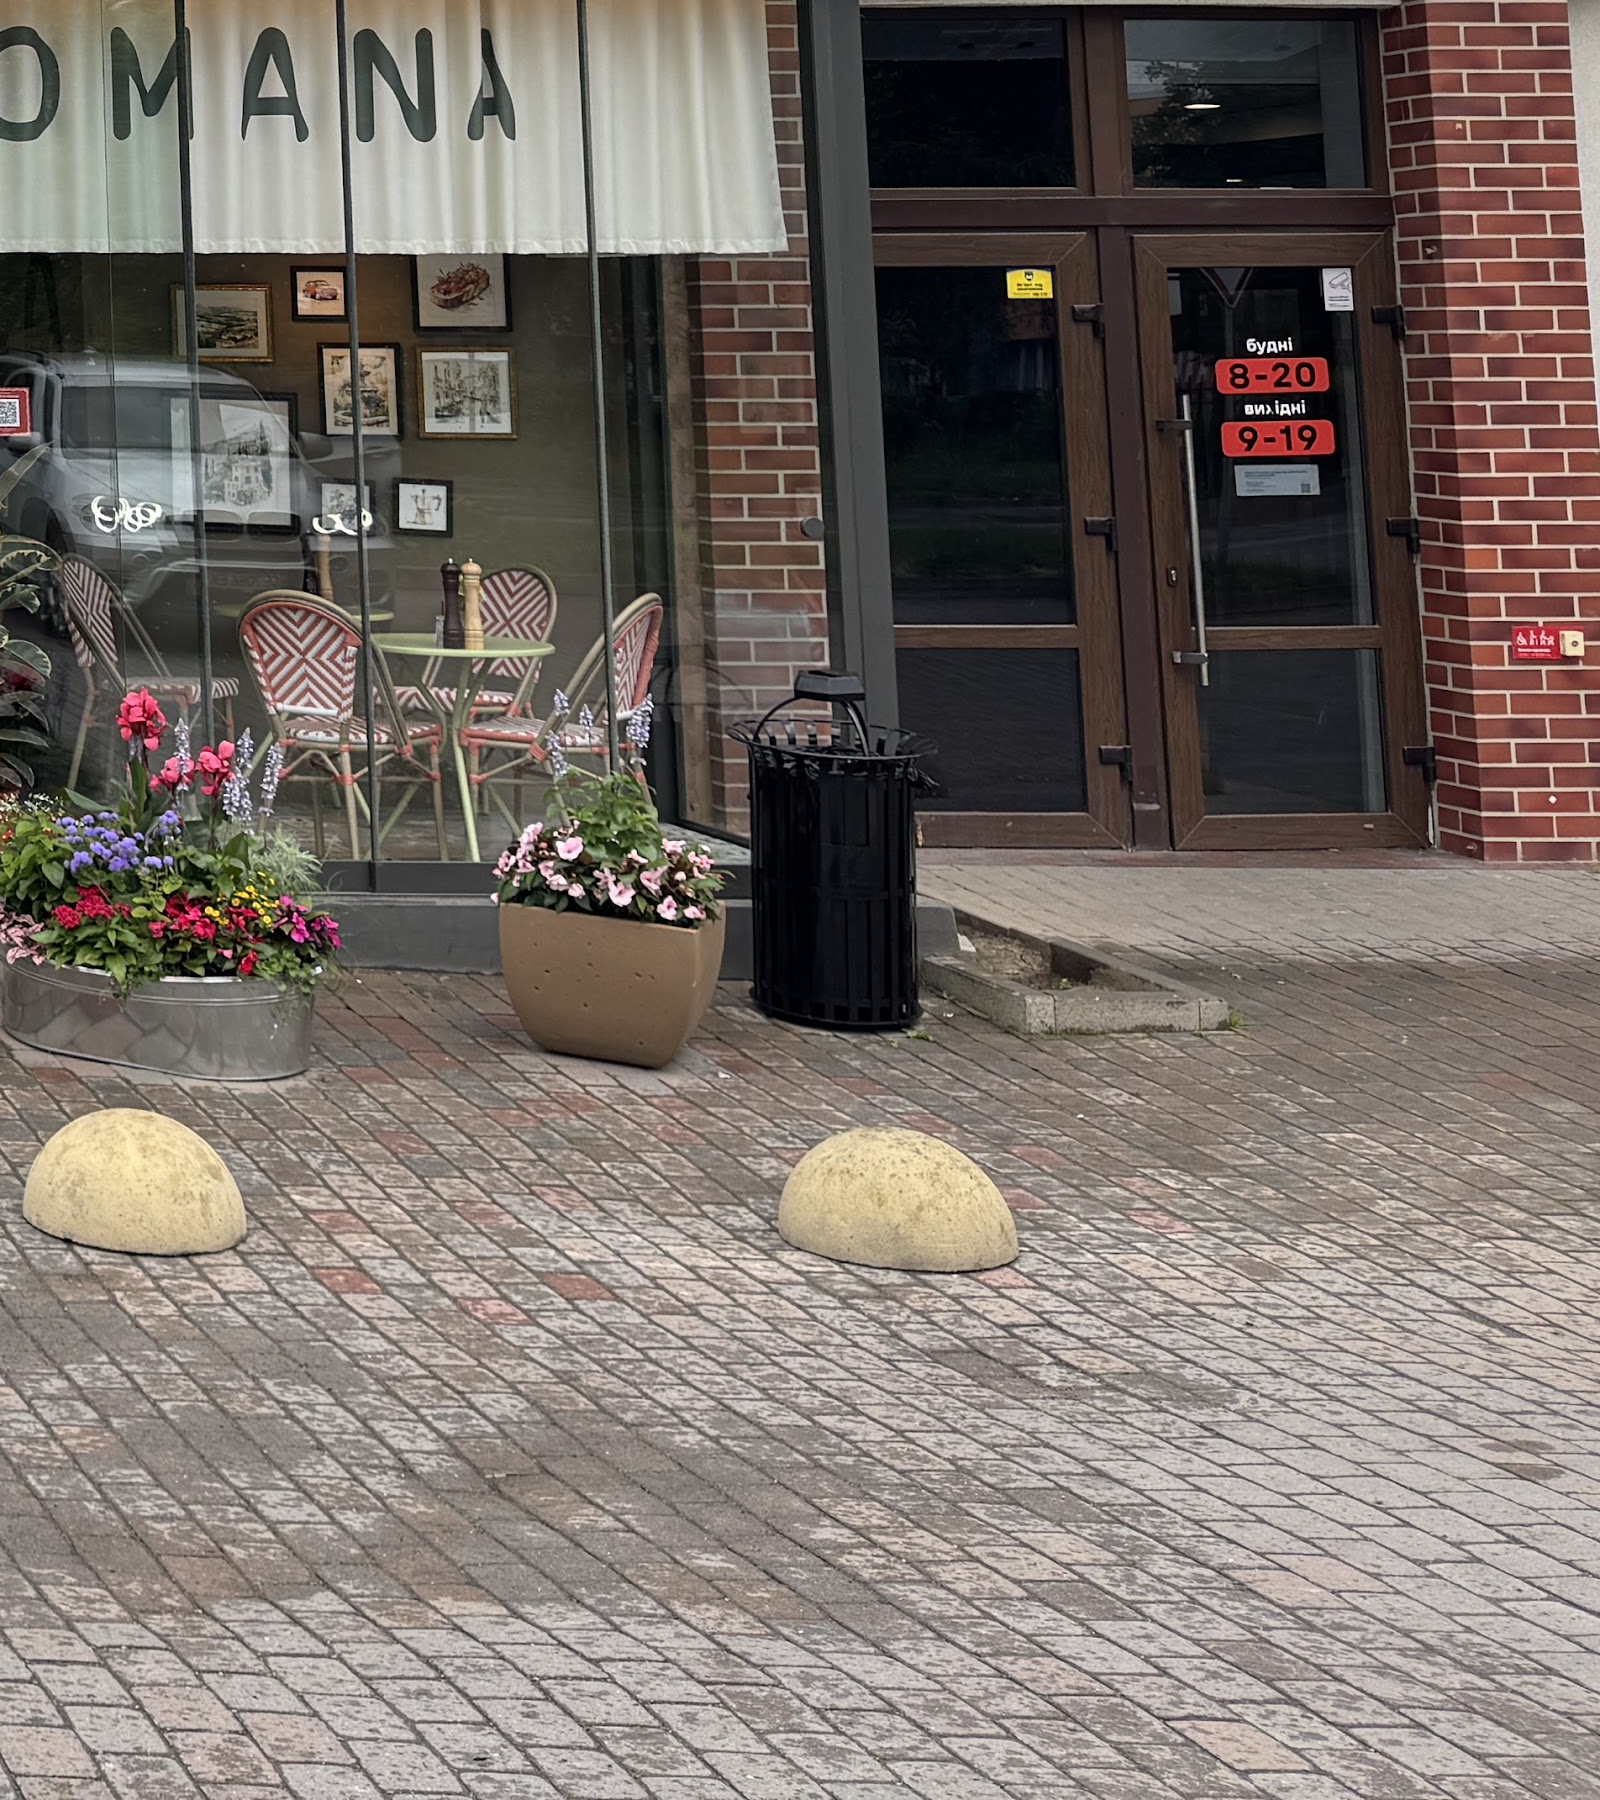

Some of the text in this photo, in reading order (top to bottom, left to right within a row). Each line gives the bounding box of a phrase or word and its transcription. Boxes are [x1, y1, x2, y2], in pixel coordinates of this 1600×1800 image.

[1246, 336, 1294, 356] будні
[1229, 361, 1316, 390] 8-20
[1244, 399, 1307, 417] вихідні
[1238, 424, 1318, 453] 9-19
